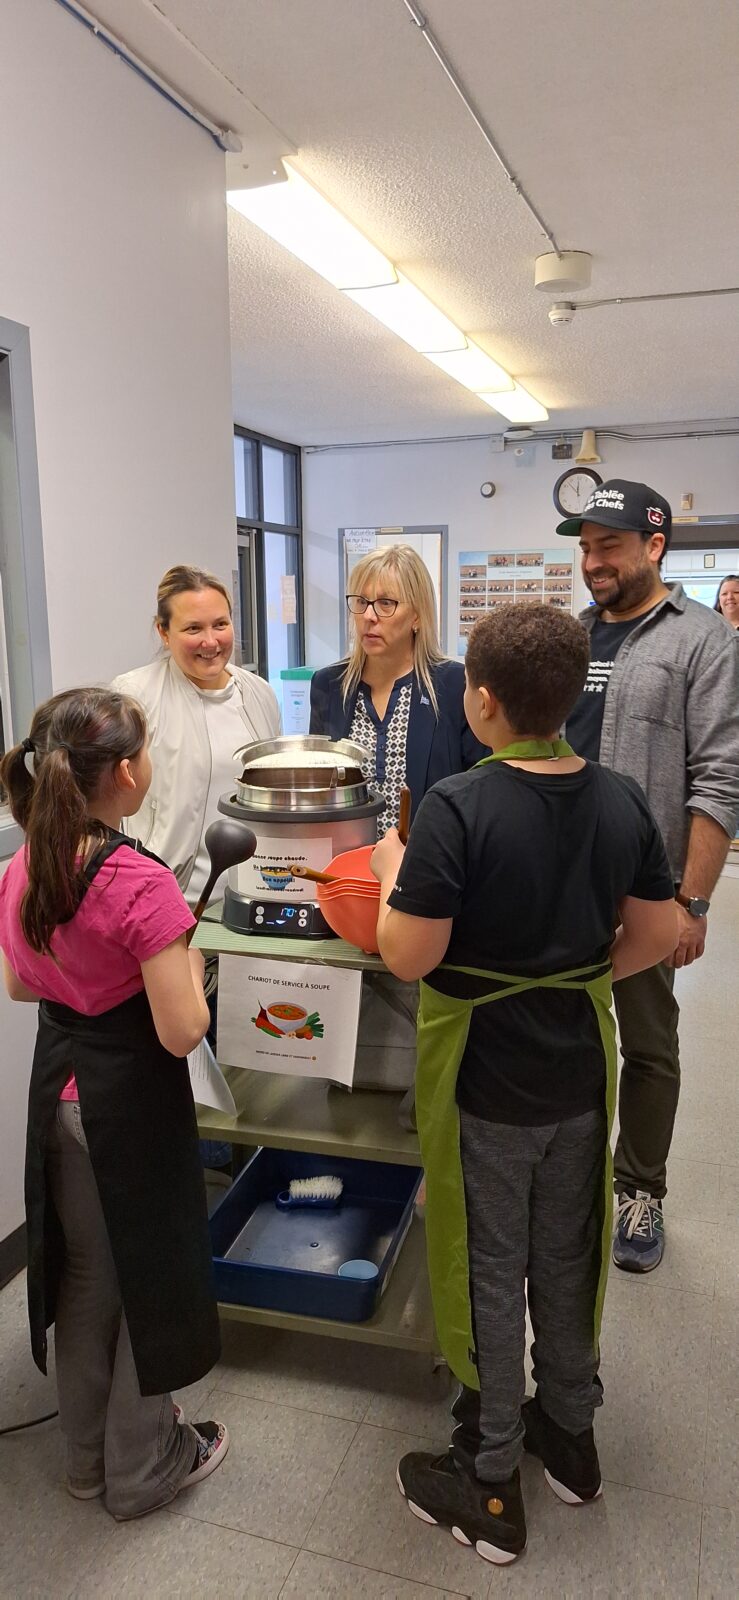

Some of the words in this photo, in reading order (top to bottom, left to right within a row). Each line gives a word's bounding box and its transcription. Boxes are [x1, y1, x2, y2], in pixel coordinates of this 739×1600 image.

[596, 499, 625, 510] Chefs
[248, 975, 272, 983] CHARIOT
[281, 980, 304, 989] SERVICE
[310, 983, 331, 991] SOUPE
